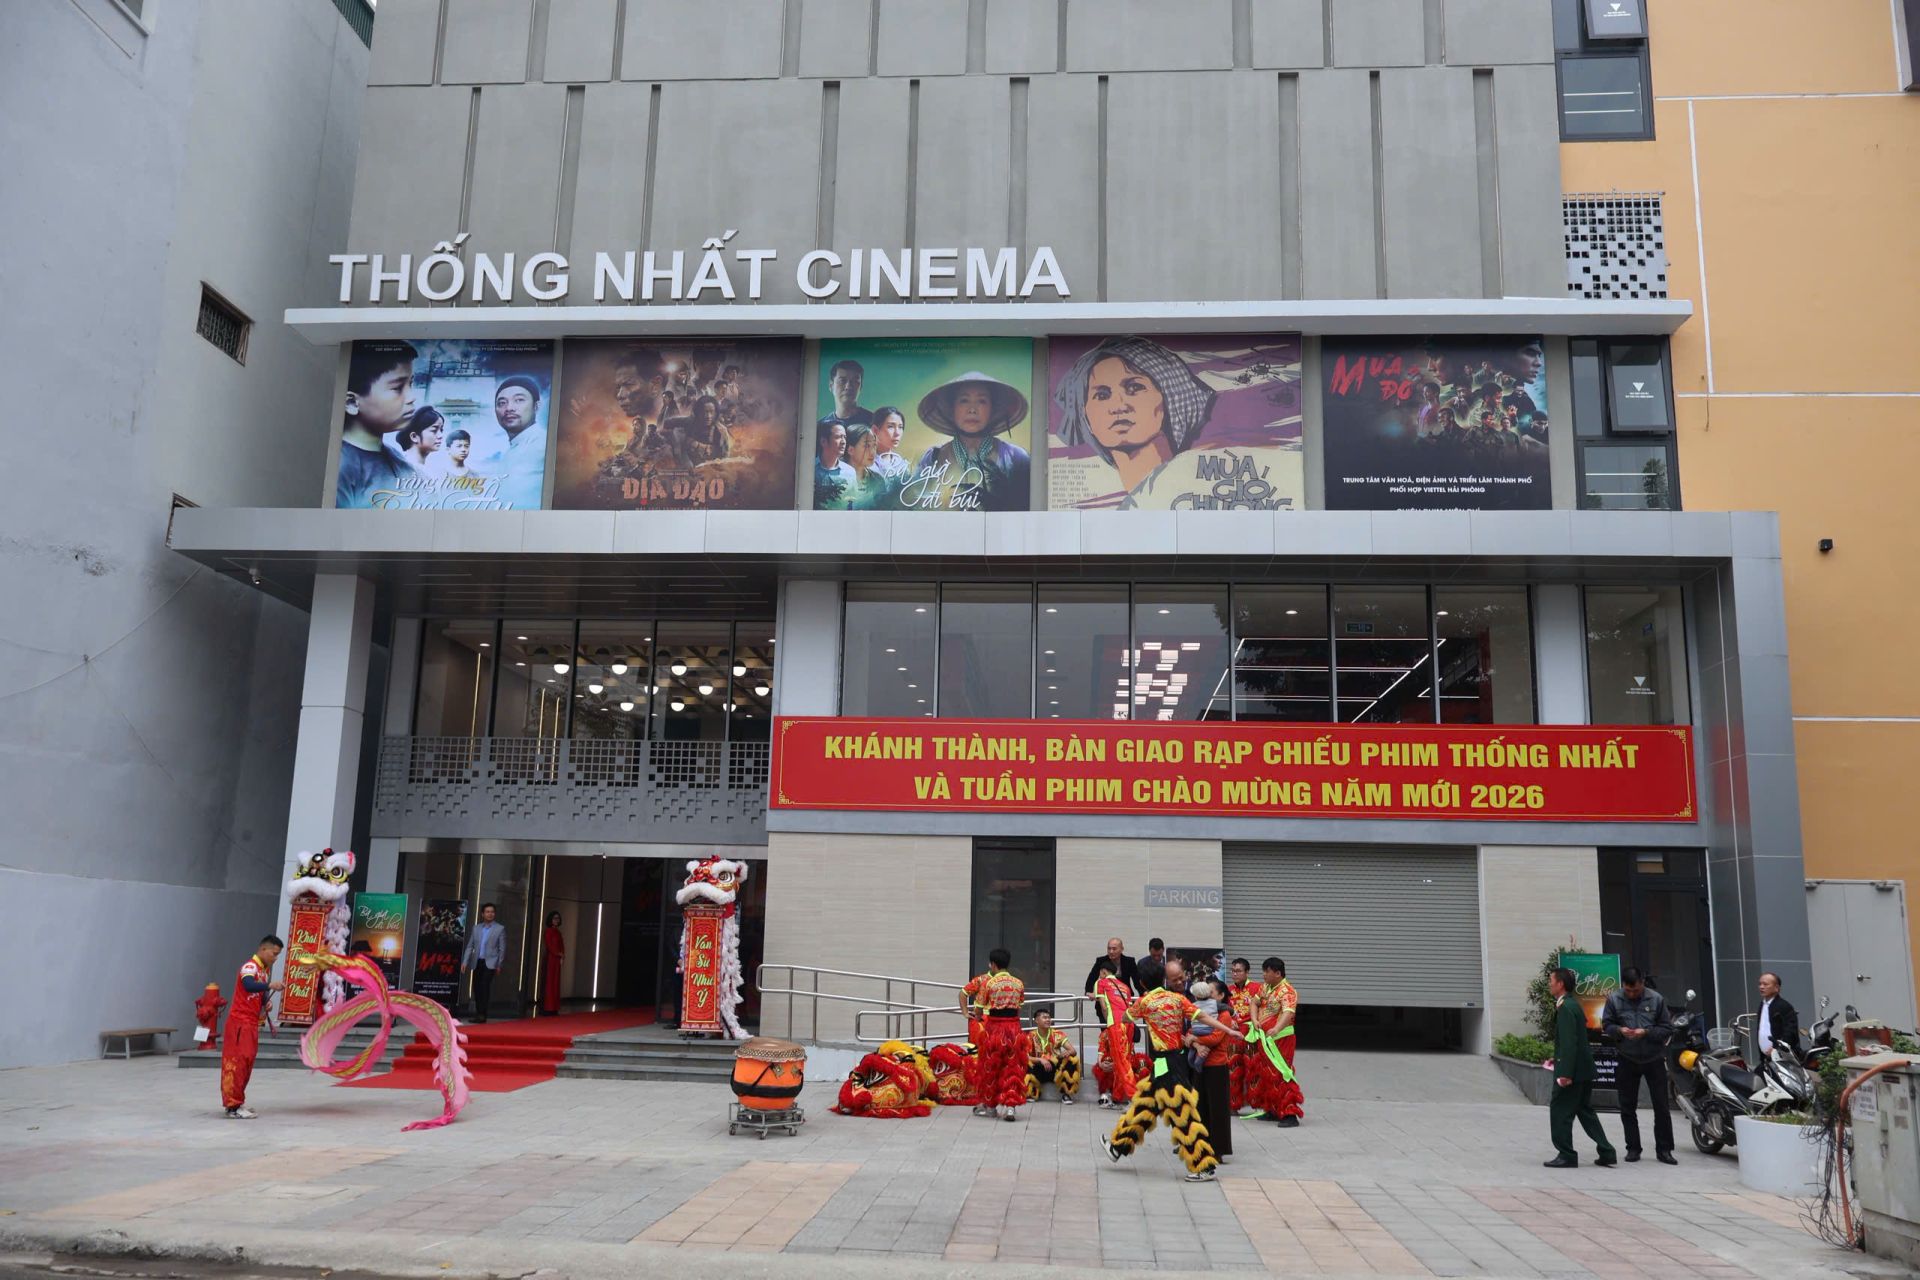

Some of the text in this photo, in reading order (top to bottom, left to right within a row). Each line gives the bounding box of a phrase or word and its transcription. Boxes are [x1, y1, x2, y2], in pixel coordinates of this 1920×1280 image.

[329, 229, 1071, 302] THỐNG NHẤT CINEMA
[1195, 449, 1259, 481] MÙA
[900, 459, 953, 507] già
[1366, 475, 1381, 484] TÂM
[1494, 476, 1517, 484] THÀNH
[824, 731, 1639, 770] KHÁNH THÀNH, BÀN GIAO RẠP CHIẾU PHIM THỐNG NHẤT
[914, 770, 1544, 810] VÀ TUẦN PHIM CHÀO MỪNG NĂM MỚI 2026
[1148, 889, 1220, 905] PARKING
[296, 928, 318, 944] Khai
[289, 983, 312, 998] Phát
[696, 988, 709, 1009] Ý
